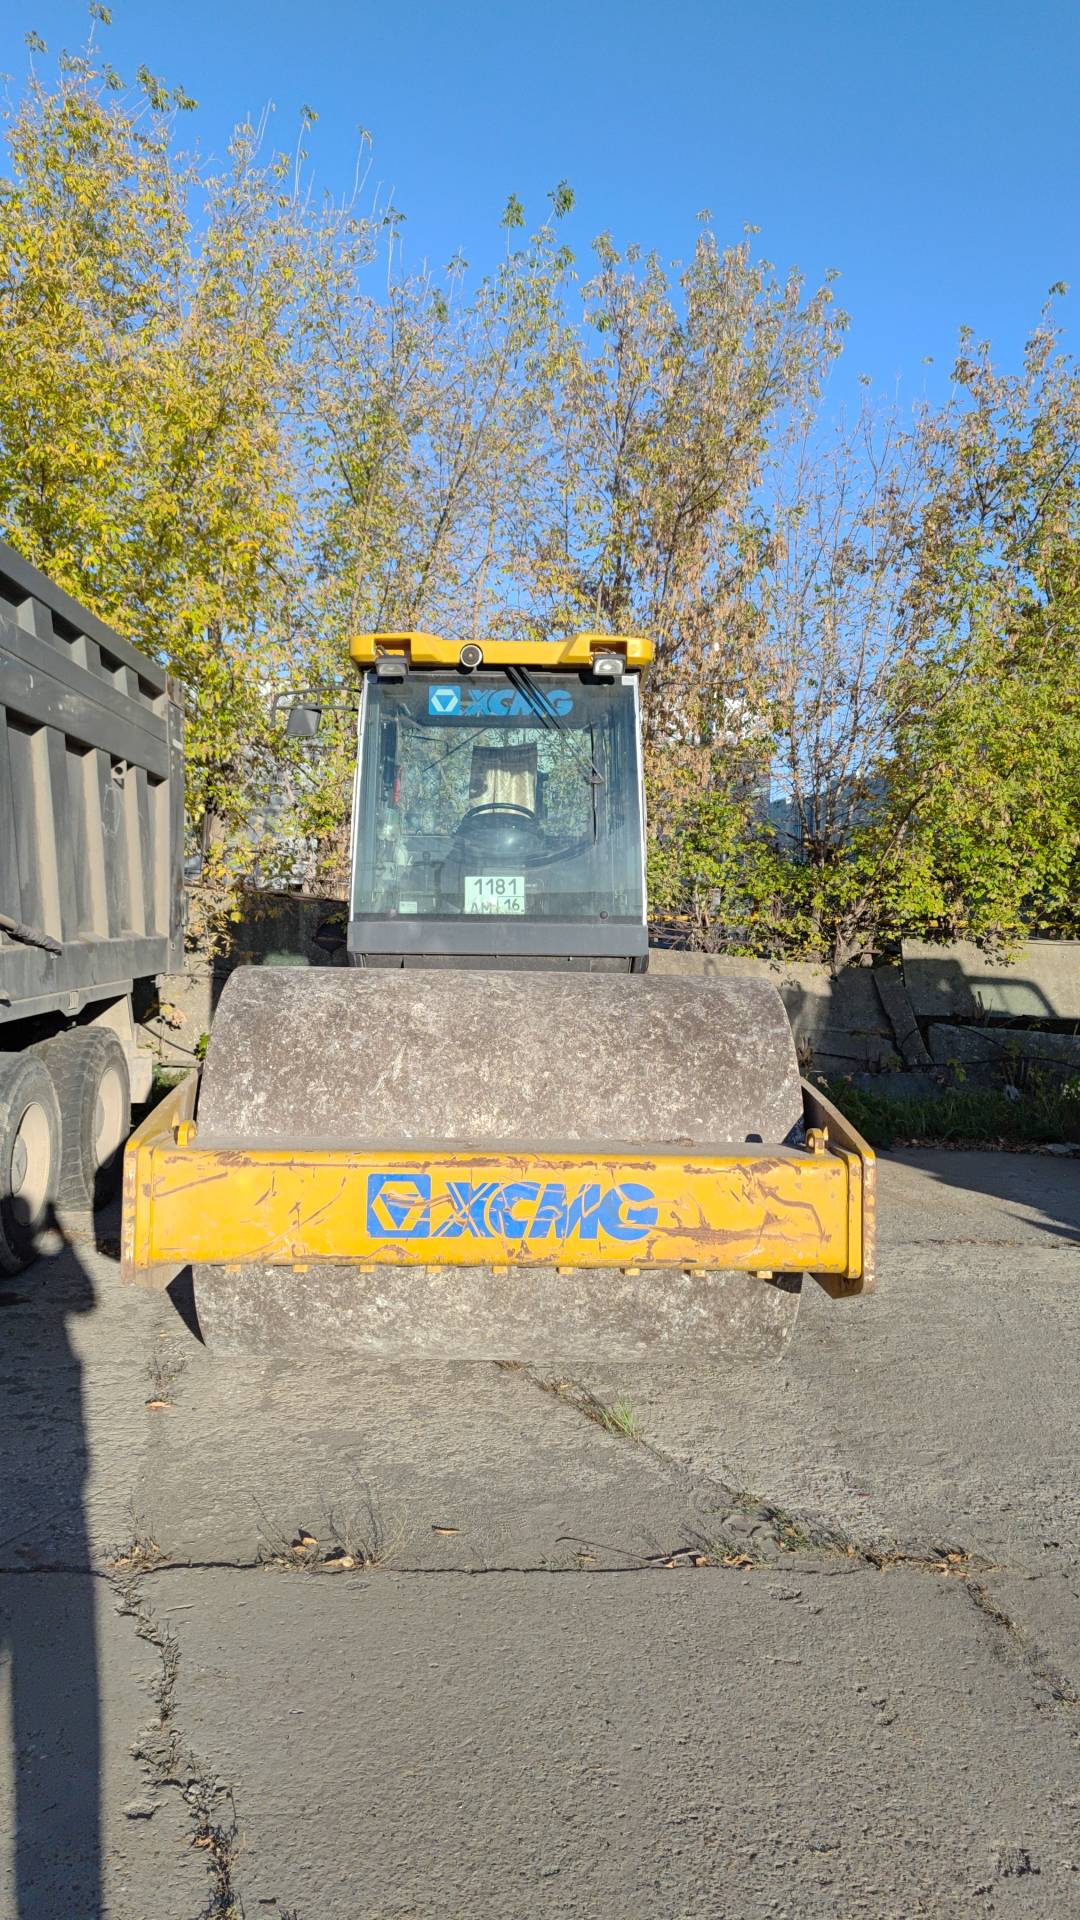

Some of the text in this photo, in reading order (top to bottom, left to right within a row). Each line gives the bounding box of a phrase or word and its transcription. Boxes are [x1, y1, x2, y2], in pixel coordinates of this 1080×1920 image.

[465, 688, 574, 716] XCMG
[474, 878, 517, 896] 1181
[503, 898, 520, 912] 16
[430, 1181, 659, 1241] XCMG
